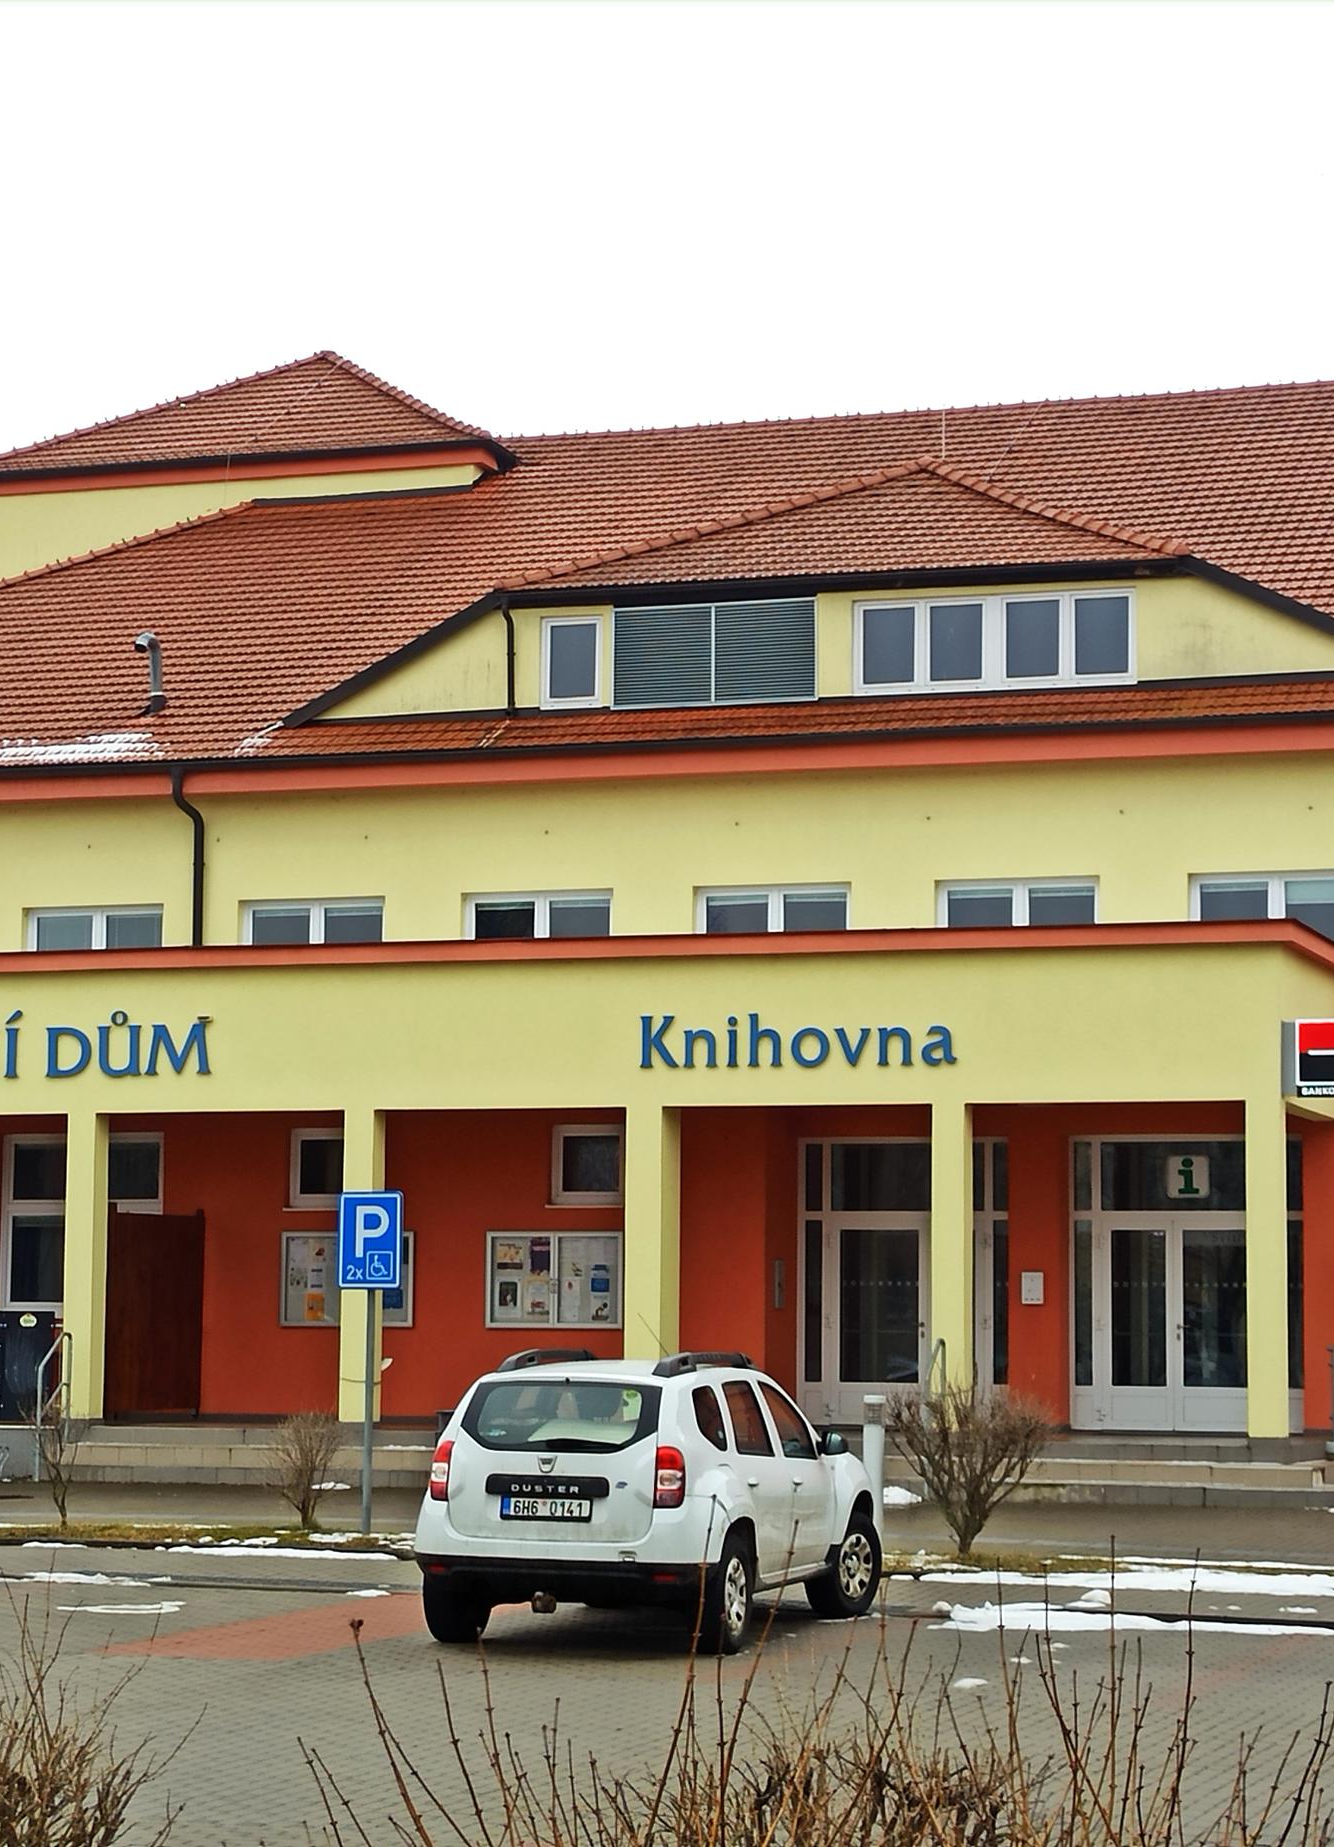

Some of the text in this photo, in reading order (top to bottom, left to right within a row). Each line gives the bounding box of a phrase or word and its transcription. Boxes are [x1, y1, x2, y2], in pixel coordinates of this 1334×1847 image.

[45, 1010, 213, 1078] DŮM
[639, 1014, 958, 1069] Knihovna
[355, 1206, 389, 1257] P
[346, 1265, 363, 1280] 2x
[511, 1484, 580, 1494] DUSTER
[513, 1499, 539, 1515] 6H6
[549, 1500, 583, 1517] 0141
